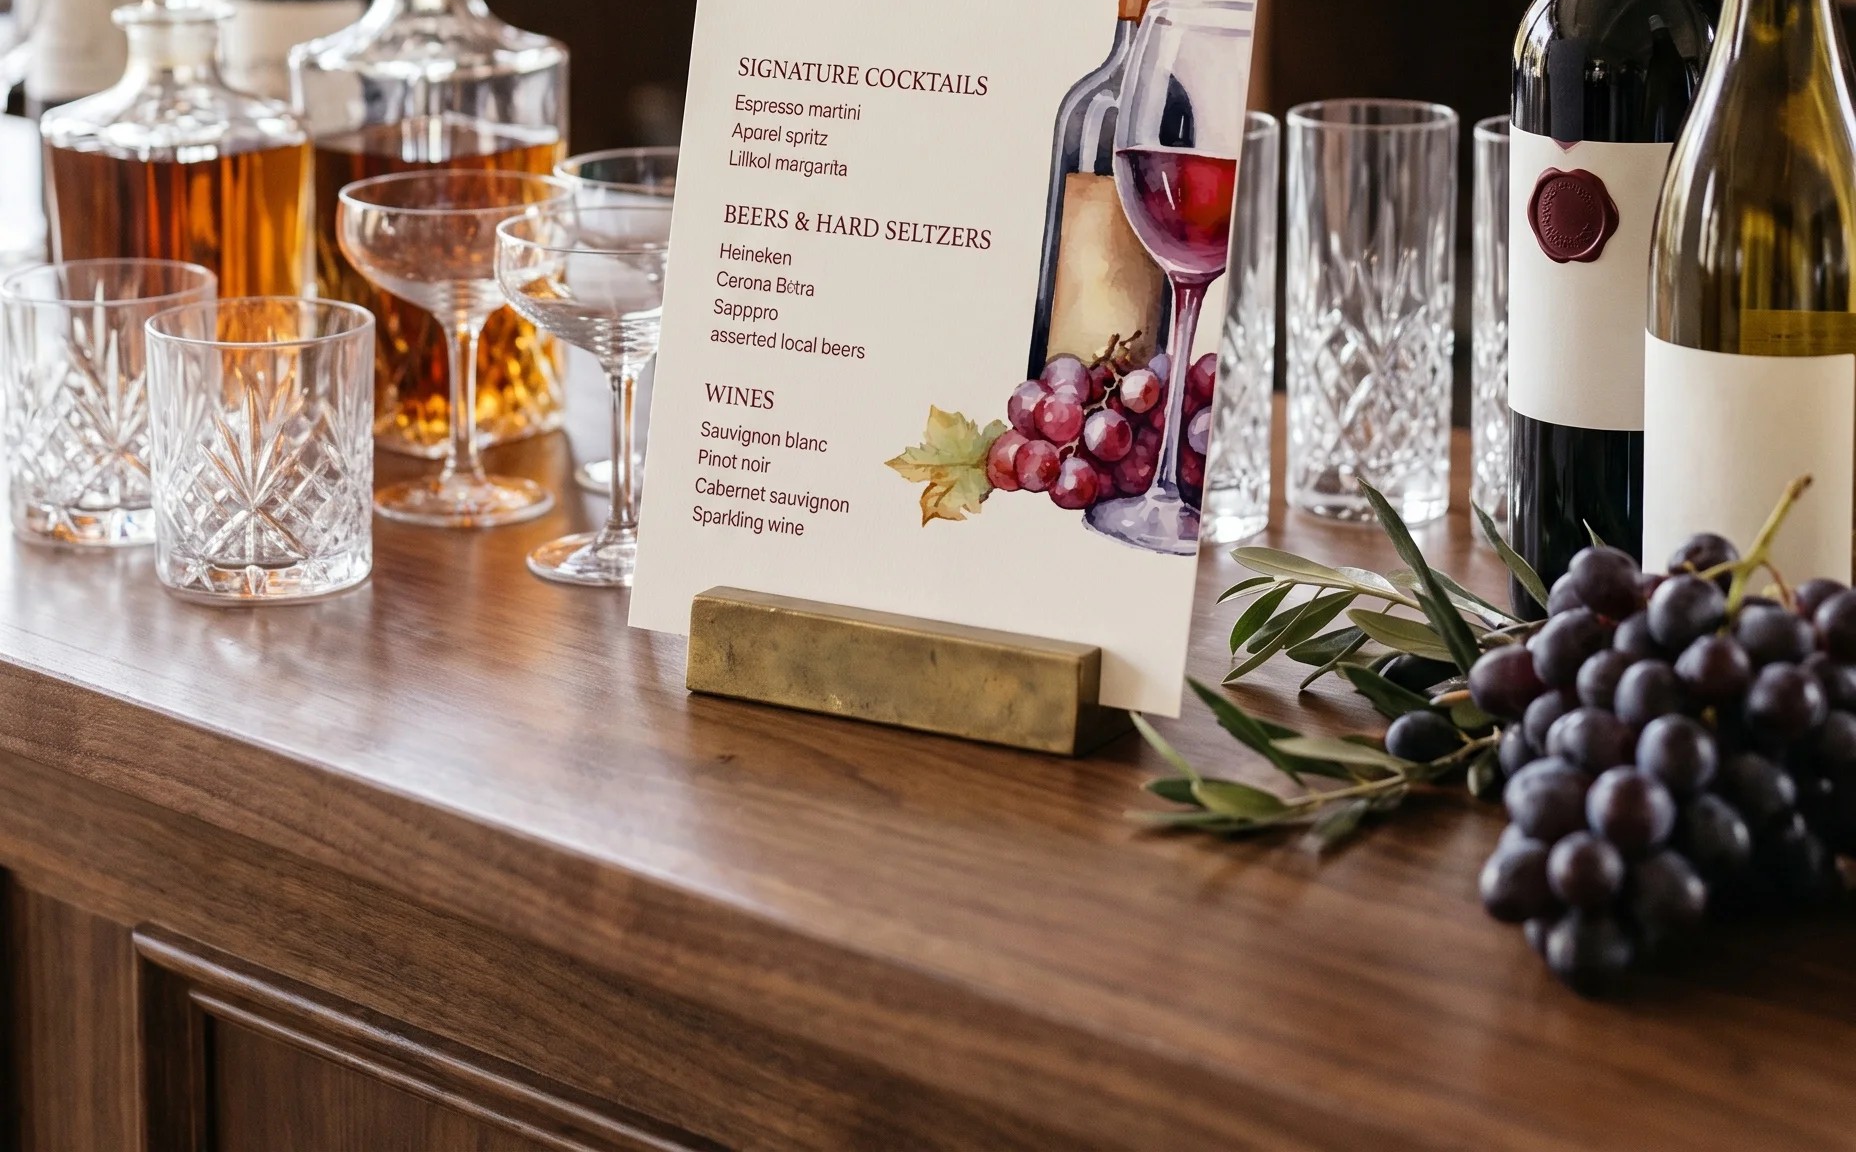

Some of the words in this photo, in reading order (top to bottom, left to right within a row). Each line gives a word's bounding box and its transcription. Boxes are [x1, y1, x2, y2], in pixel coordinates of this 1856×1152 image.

[738, 57, 859, 86] SIGNATURE
[865, 68, 988, 97] COCKTAILS
[735, 94, 804, 116] Espresso
[809, 104, 861, 121] martini
[785, 129, 828, 147] spritz
[729, 150, 771, 169] Lillkol
[775, 158, 848, 178] margarita
[724, 204, 789, 229] BEERS
[794, 212, 810, 231] &
[816, 214, 879, 238] HARD
[885, 220, 992, 250] SELTZERS
[719, 243, 792, 266] Heineken
[716, 271, 771, 292] Cerona
[713, 298, 779, 323] Sapppro
[710, 330, 777, 349] asserted
[781, 333, 817, 354] local
[821, 338, 866, 359] beers
[705, 383, 775, 410] WINES
[700, 421, 781, 448] Sauvignon
[785, 431, 828, 452] blanc
[698, 449, 738, 470] Pinot
[741, 456, 771, 474] noir
[695, 477, 767, 502] Cabernet
[769, 491, 850, 514] sauvignon
[692, 506, 764, 535] Sparkling
[768, 517, 805, 536] wine
